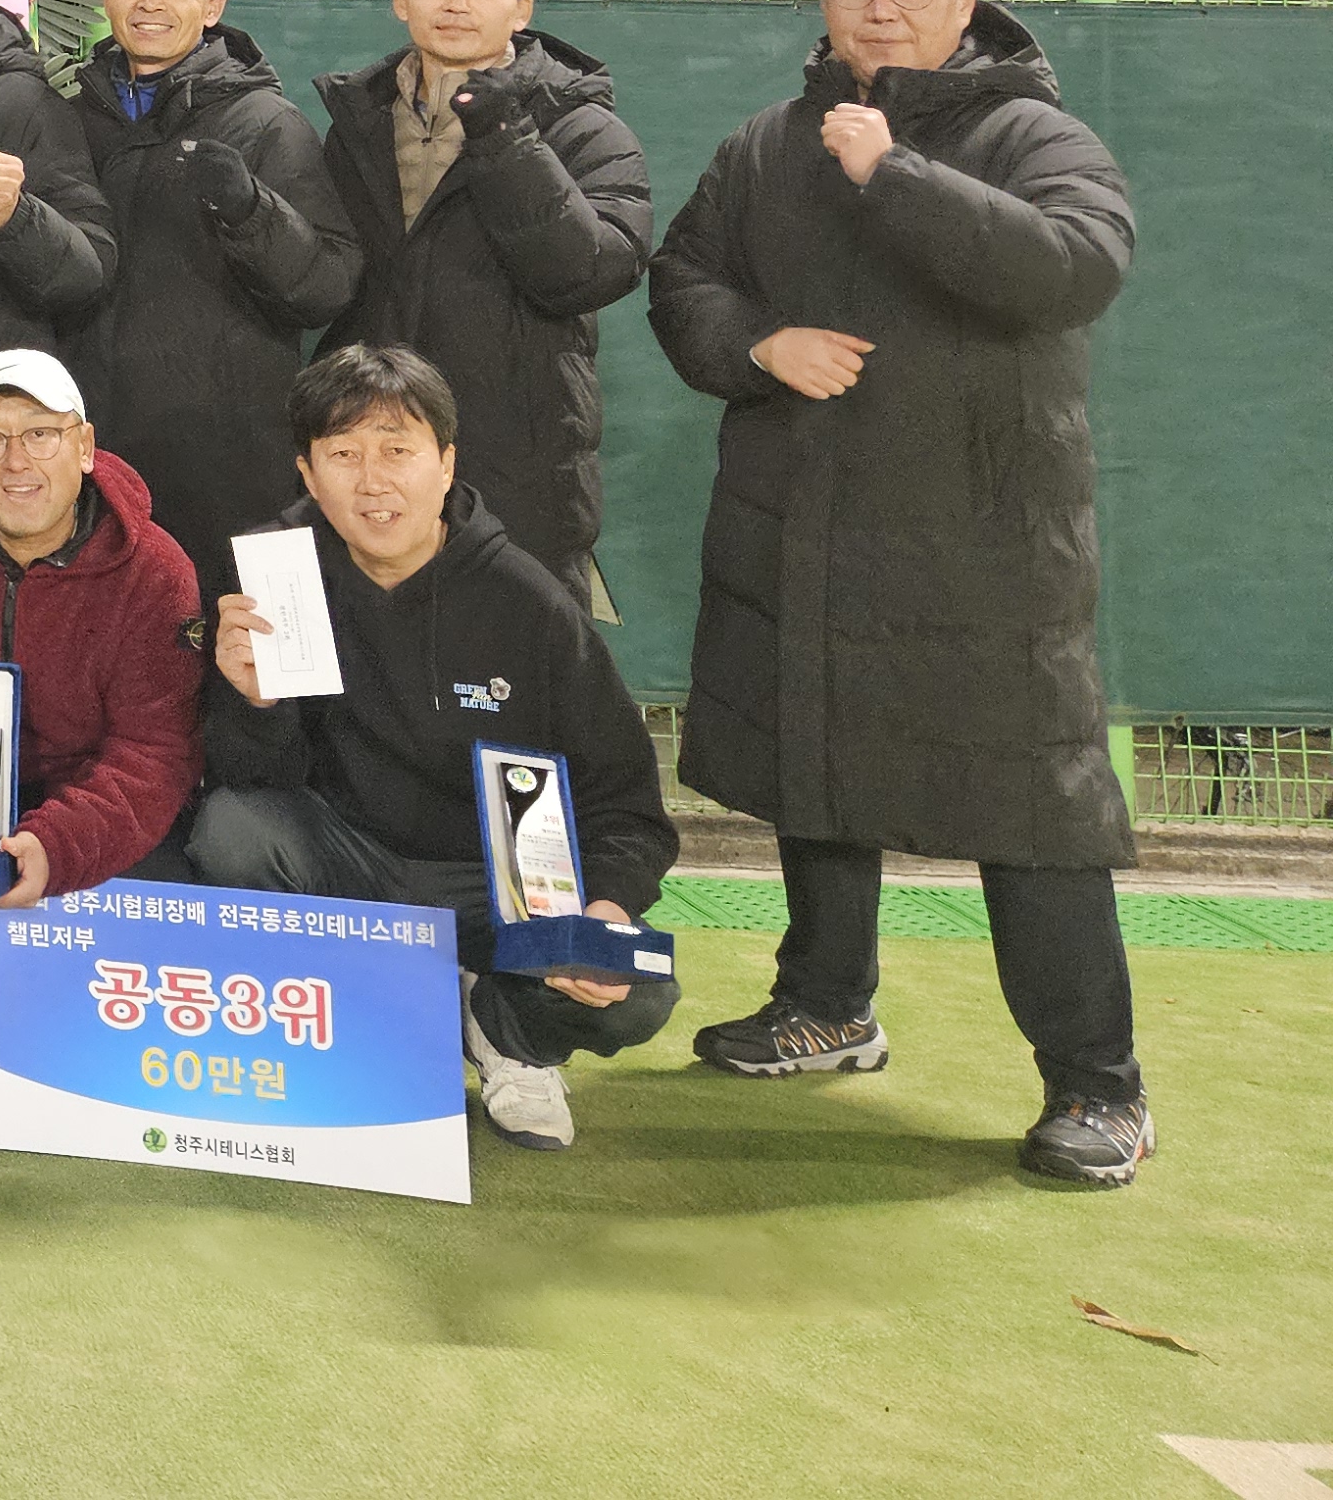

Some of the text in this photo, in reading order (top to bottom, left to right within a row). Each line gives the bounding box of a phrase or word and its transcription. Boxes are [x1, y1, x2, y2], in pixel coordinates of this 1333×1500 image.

[453, 683, 487, 696] GREEN
[460, 697, 500, 712] NATURE
[61, 890, 436, 948] 청주시협회장배 전국동호인테니스대회
[7, 920, 96, 952] 챌린저부
[89, 959, 333, 1051] 공동3위
[141, 1046, 287, 1101] 60만원
[174, 1134, 295, 1166] 청주시테니스협회
